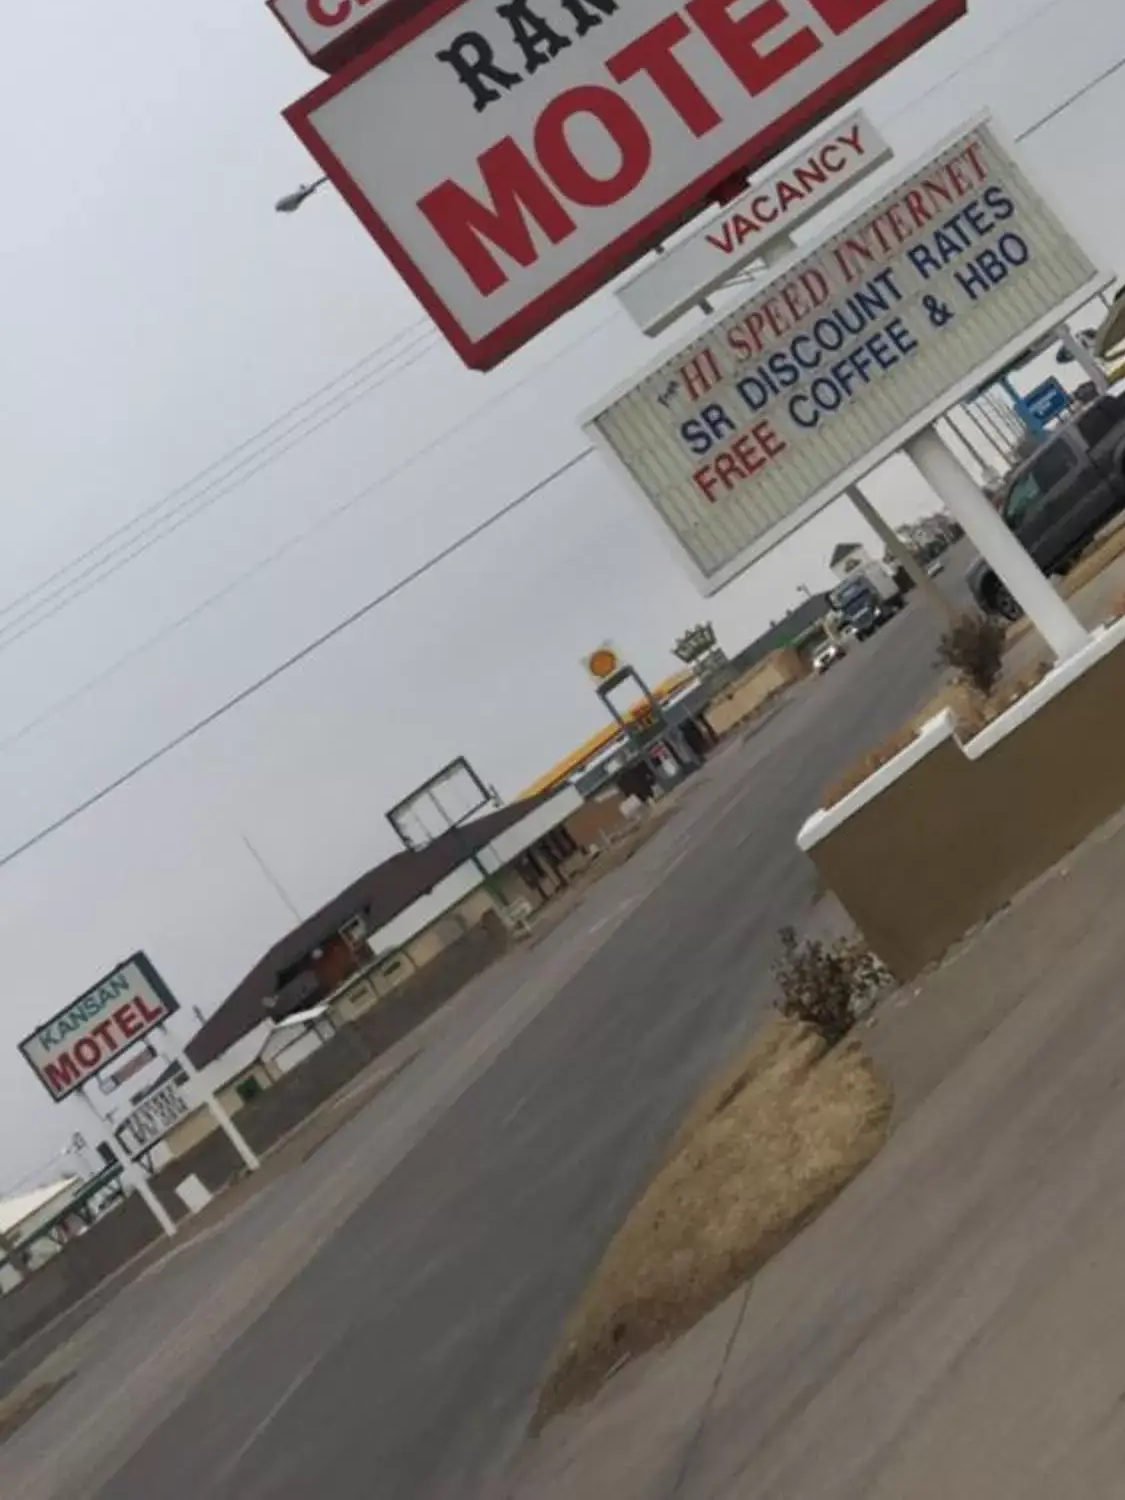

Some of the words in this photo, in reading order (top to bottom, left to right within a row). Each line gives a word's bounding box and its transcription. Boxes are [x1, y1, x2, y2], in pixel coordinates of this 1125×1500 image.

[678, 356, 722, 402] HI
[726, 268, 831, 362] SPEED
[832, 141, 989, 285] INTERNET
[706, 125, 866, 255] VACANCY
[680, 403, 738, 455] SR
[736, 268, 905, 412] DISCOUNT
[906, 185, 1015, 279] RATES
[692, 421, 787, 503] FREE
[787, 317, 918, 430] COFFEE
[921, 294, 953, 328] &
[953, 231, 1030, 301] HBO
[39, 972, 130, 1052] KANSAN
[43, 994, 164, 1091] MOTEL
